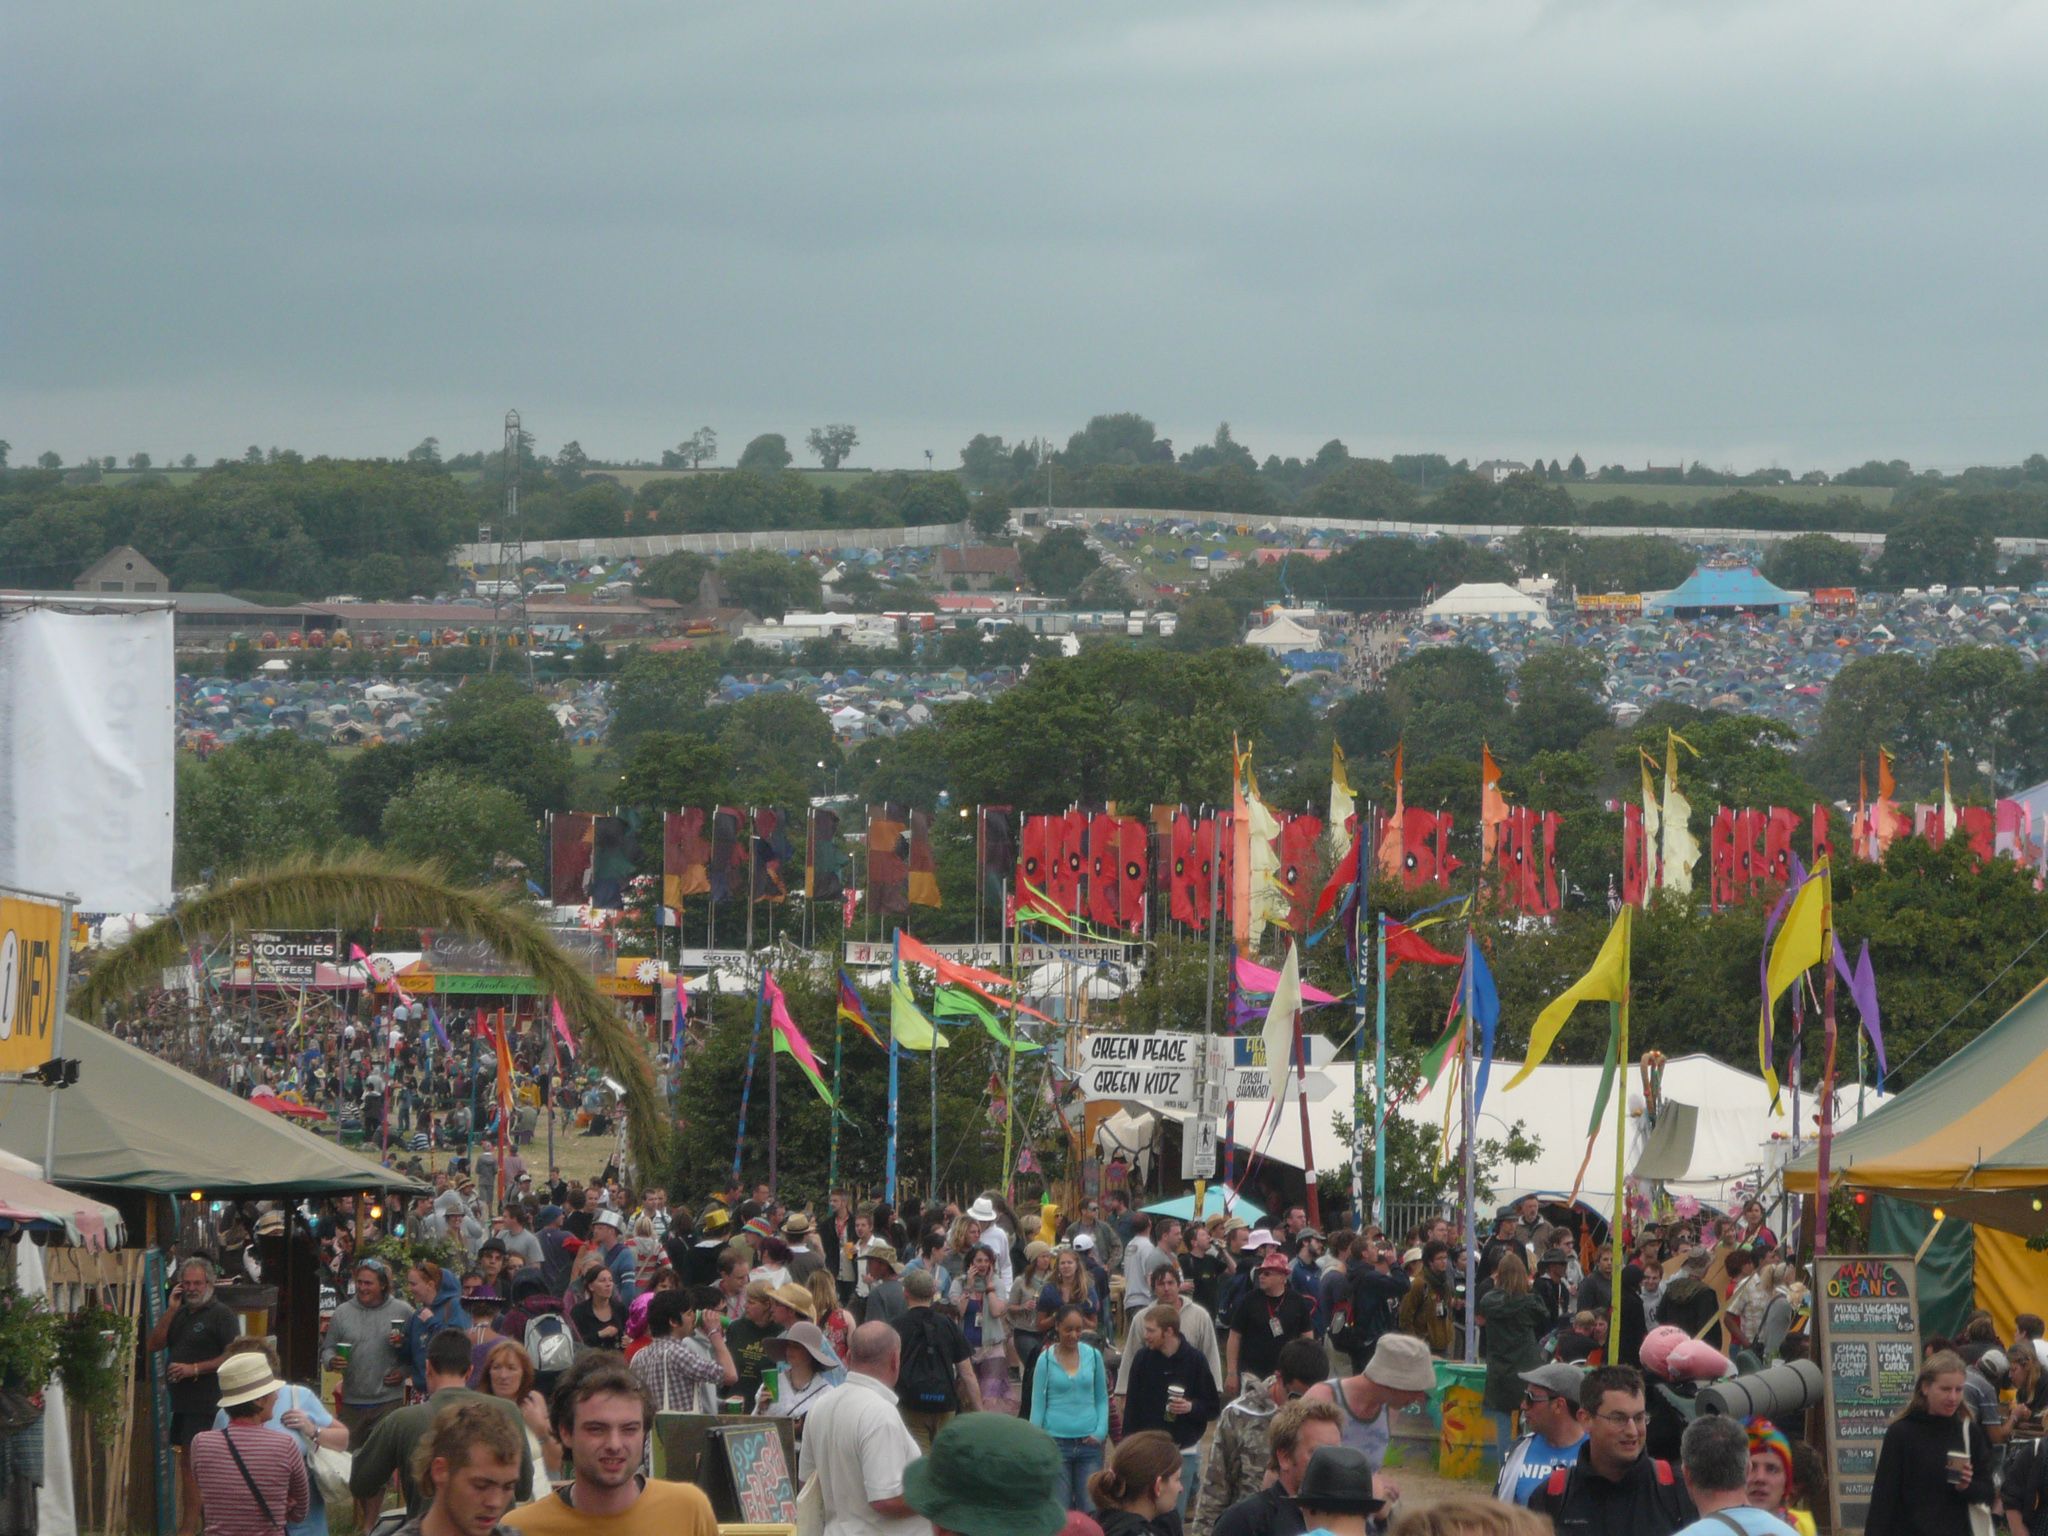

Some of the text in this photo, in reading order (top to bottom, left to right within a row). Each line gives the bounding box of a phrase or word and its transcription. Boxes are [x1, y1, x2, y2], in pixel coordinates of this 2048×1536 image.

[239, 943, 334, 957] SMOOTHIES
[257, 964, 312, 975] COFFEES
[1091, 1036, 1139, 1061] GREEN
[1142, 1038, 1188, 1063] PEACE
[1093, 1070, 1181, 1095] GREEN KIDZ
[1239, 1072, 1264, 1086] TRASH
[1519, 1463, 1553, 1479] NIP
